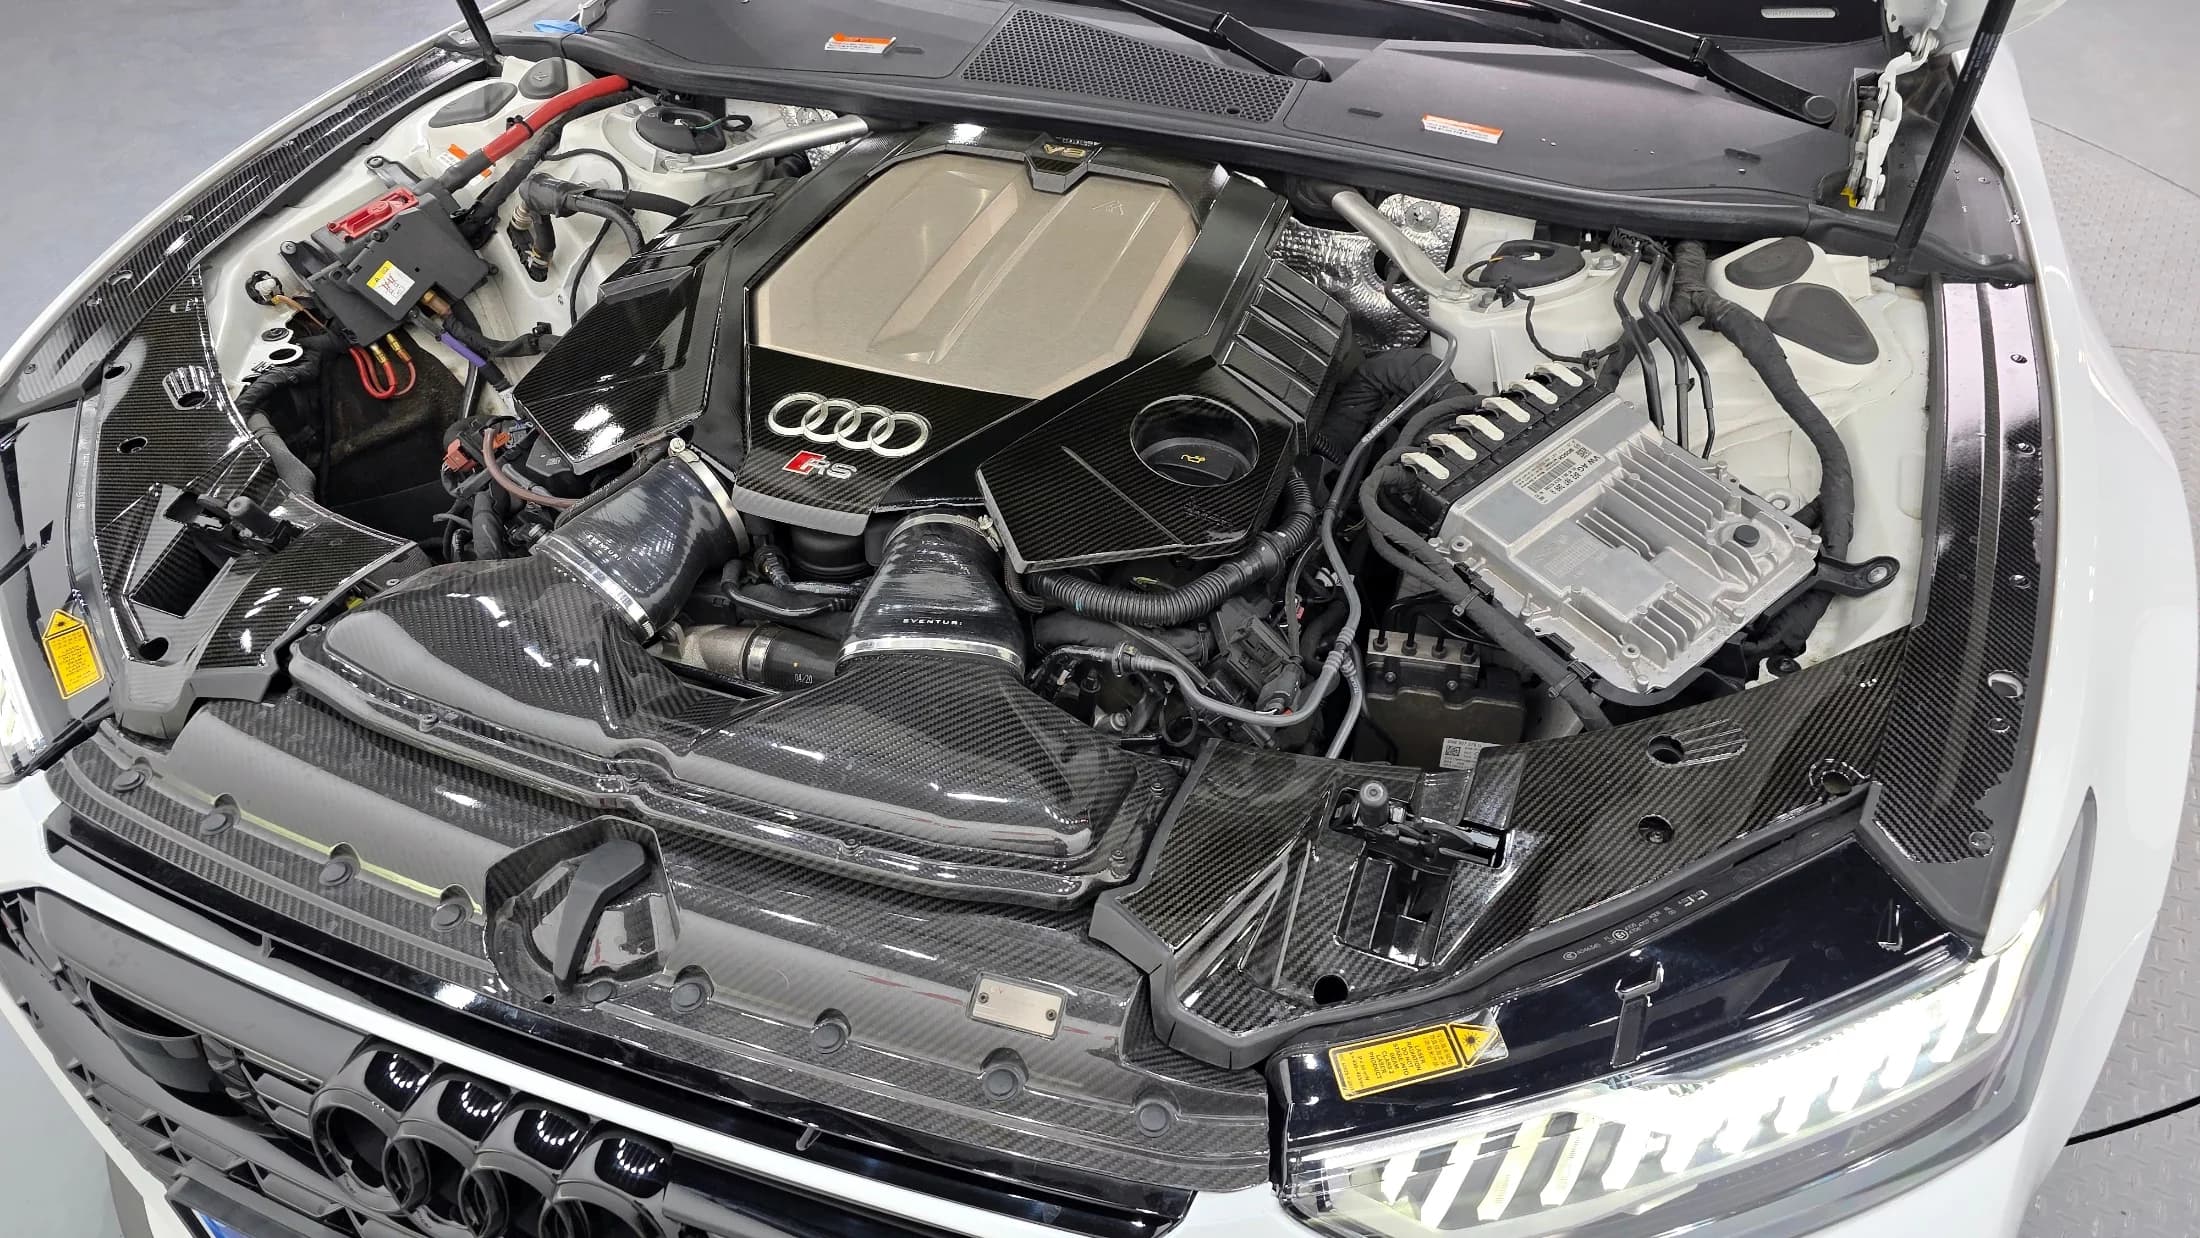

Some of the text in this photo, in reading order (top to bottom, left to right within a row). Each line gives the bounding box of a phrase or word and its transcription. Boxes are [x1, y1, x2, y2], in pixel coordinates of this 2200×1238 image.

[1043, 143, 1087, 158] V8
[800, 458, 857, 479] RS
[1577, 455, 1601, 472] VW AG
[1381, 1050, 1392, 1069] CLASS
[1389, 1052, 1399, 1069] BEAM
[1393, 1043, 1409, 1075] STARE INTO
[1401, 1046, 1413, 1068] DO NOT
[1407, 1041, 1421, 1071] RADIATION
[1414, 1044, 1424, 1063] LASER
[1368, 1051, 1382, 1079] PRODUCT
[1376, 1054, 1386, 1073] LASER
